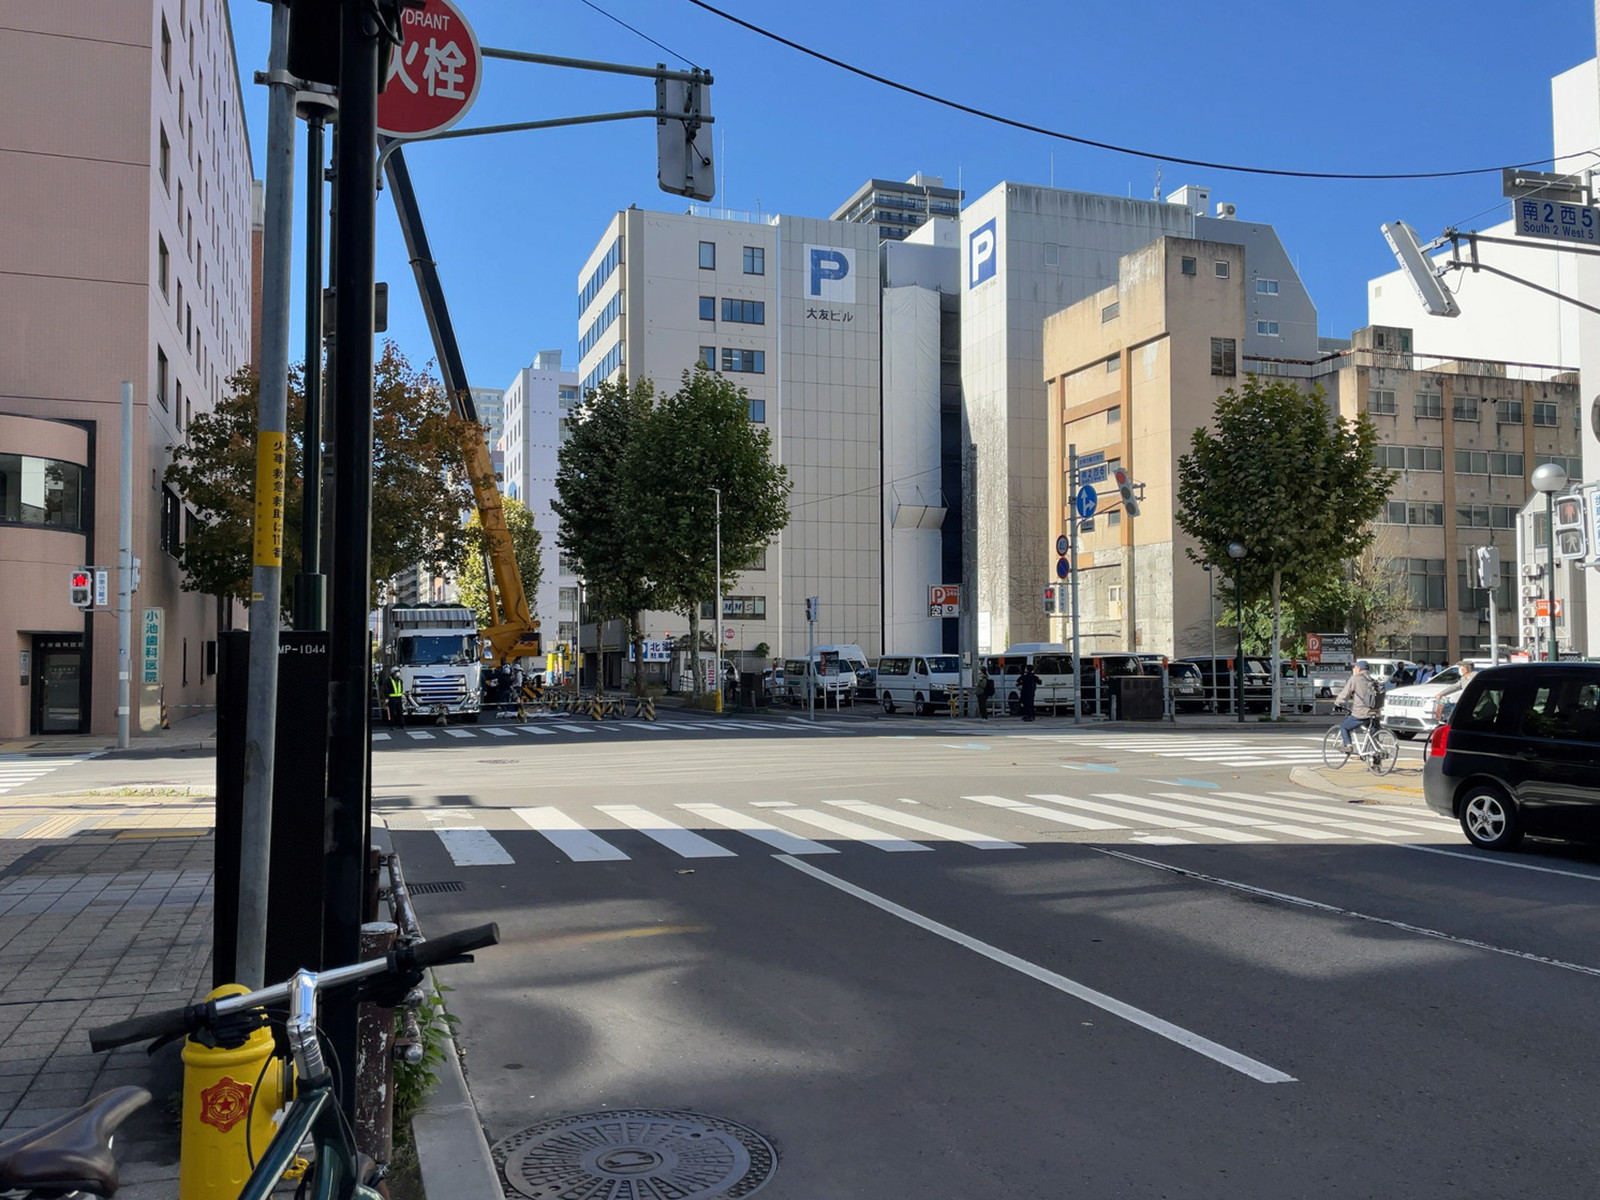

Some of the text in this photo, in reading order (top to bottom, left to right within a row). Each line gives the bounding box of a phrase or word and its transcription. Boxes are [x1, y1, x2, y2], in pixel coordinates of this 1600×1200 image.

[1523, 221, 1594, 240] South 2 West 5
[810, 249, 849, 296] P
[971, 229, 995, 283] P
[806, 307, 853, 322] 大友ビル
[145, 610, 158, 683] 小池歯科医院
